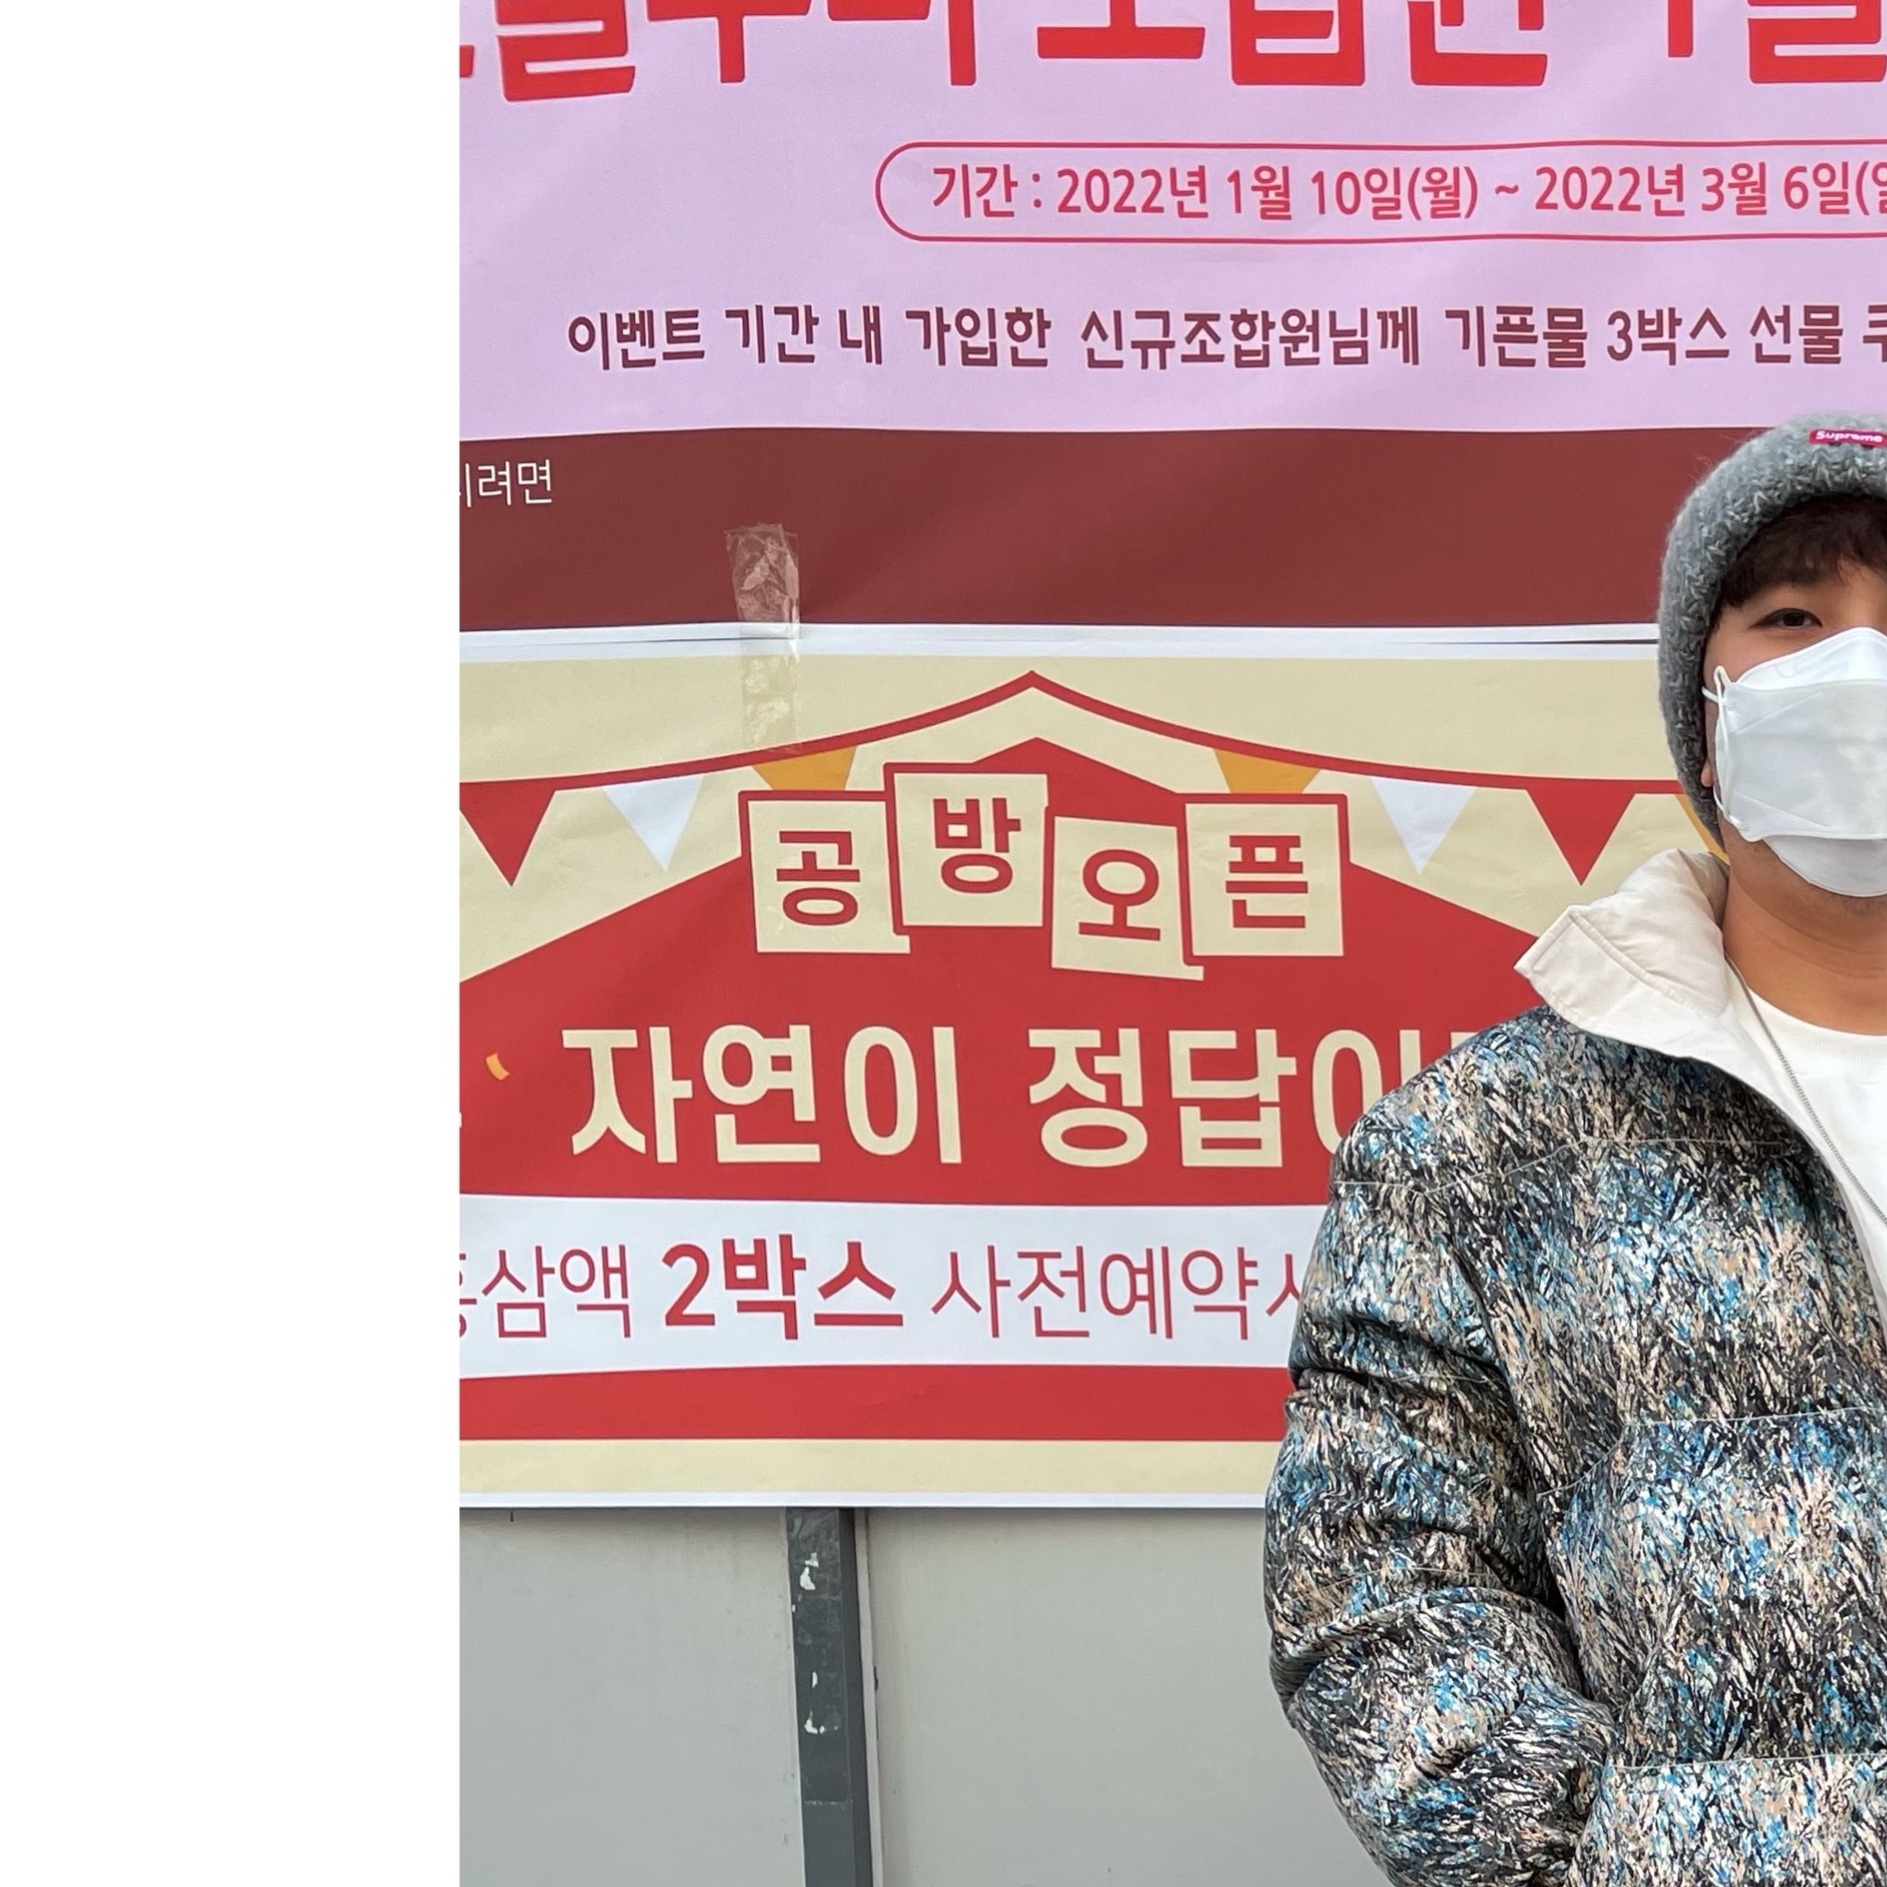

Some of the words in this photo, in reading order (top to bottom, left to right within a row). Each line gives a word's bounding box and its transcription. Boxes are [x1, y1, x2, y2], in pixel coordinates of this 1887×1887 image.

[934, 164, 1018, 218] 기간
[1058, 165, 1208, 218] 2022년
[1228, 166, 1291, 220] 1월
[1312, 167, 1477, 220] 10일(월)
[1536, 164, 1684, 216] 2022년
[1702, 162, 1767, 215] 3월
[569, 310, 704, 370] 이벤트
[726, 305, 819, 363] 기간
[839, 306, 882, 364] 내
[906, 307, 1051, 367] 가입한
[1081, 307, 1419, 370] 신규조합원님께
[1446, 306, 1587, 368] 기픈물
[1608, 308, 1729, 365] 3박스
[1750, 305, 1843, 364] 선물
[1816, 430, 1883, 443] Supreme
[562, 1025, 961, 1163] 자연이
[1027, 1028, 1478, 1167] 정답이
[663, 1234, 903, 1340] 2박스
